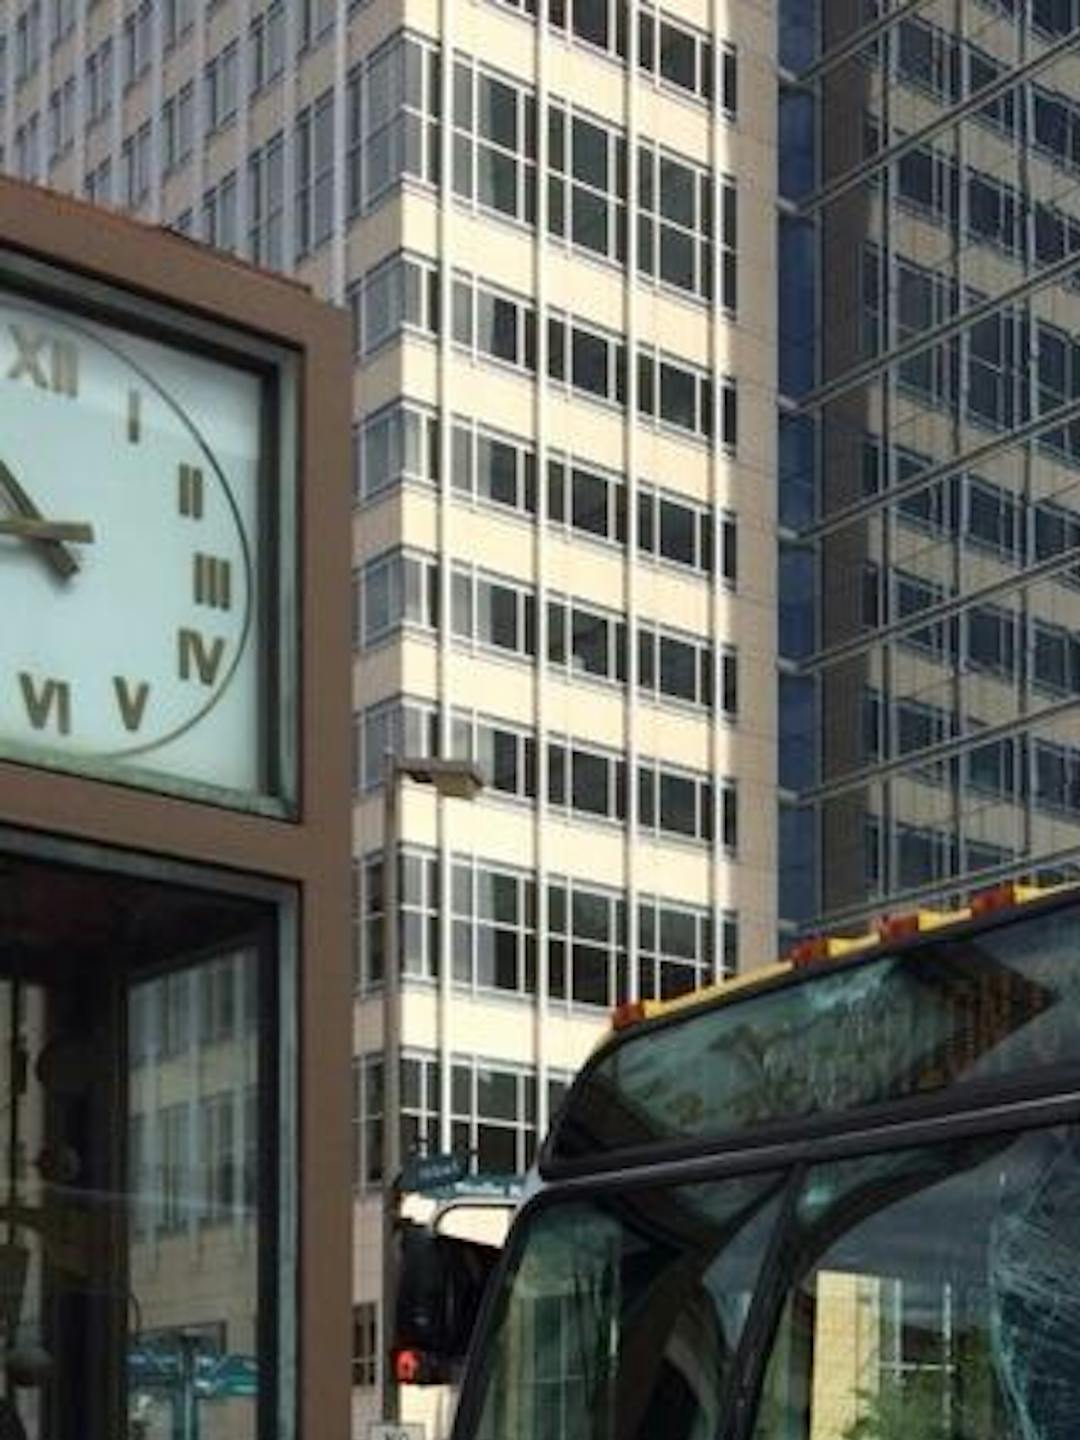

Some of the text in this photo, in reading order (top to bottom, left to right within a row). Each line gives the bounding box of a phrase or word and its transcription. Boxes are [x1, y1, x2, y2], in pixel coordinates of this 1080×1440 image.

[9, 323, 79, 398] XII
[127, 389, 141, 444] I
[178, 463, 203, 520] II
[194, 551, 231, 611] III
[178, 627, 224, 686] IV
[18, 671, 71, 736] VI
[113, 675, 149, 733] V
